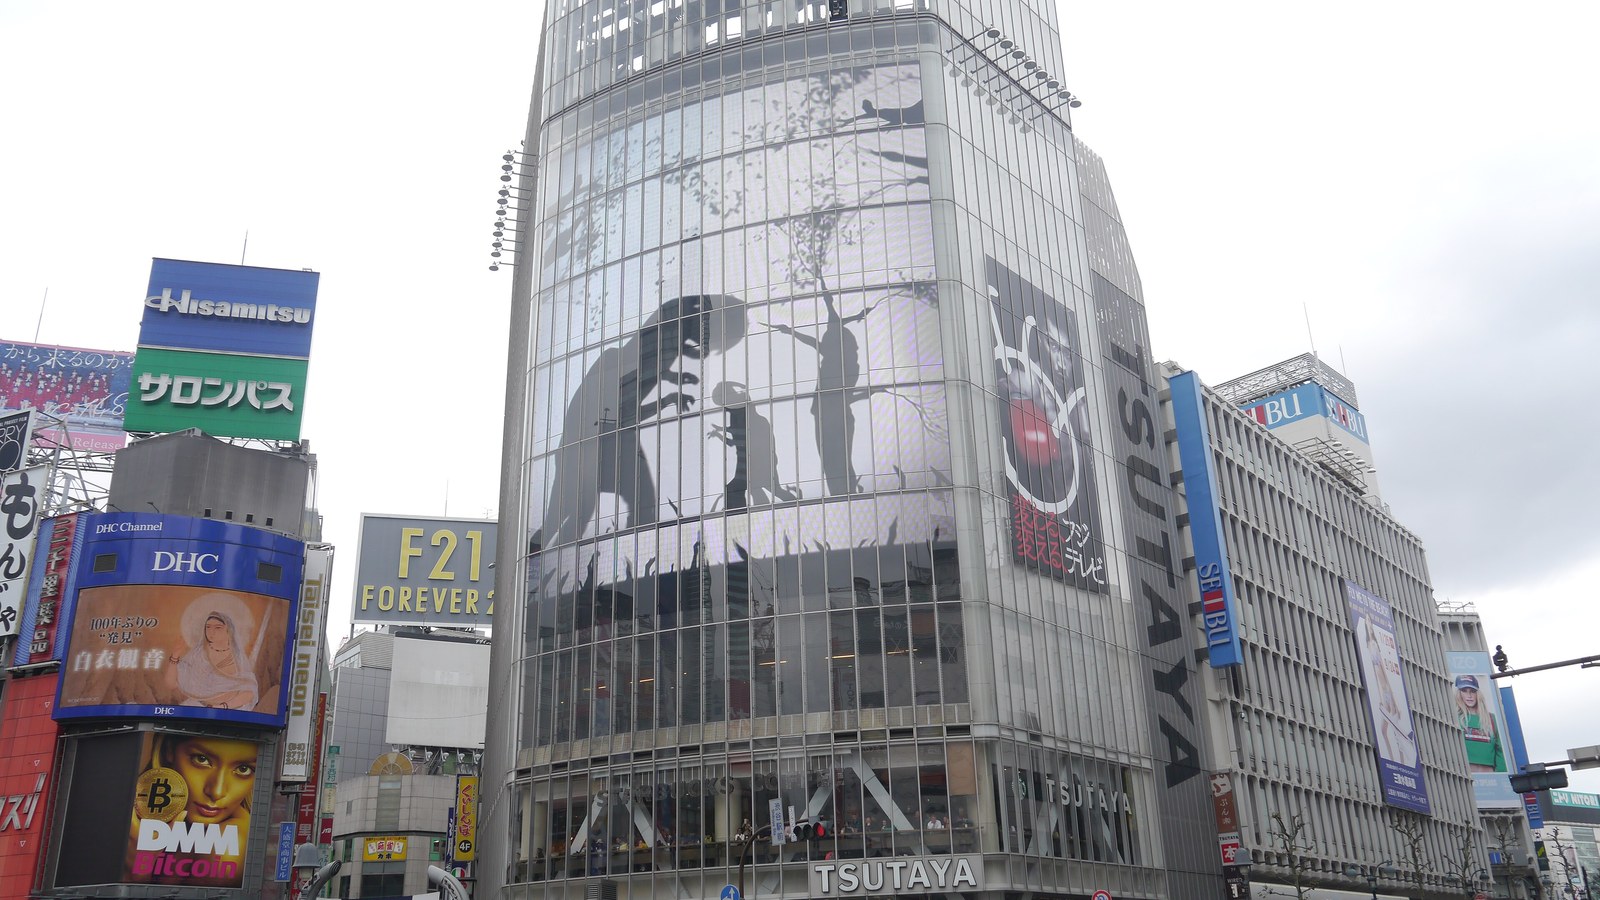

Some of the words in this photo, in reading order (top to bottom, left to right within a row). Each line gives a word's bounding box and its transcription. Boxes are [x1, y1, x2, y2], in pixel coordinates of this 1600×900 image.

[144, 287, 311, 324] Hisamitsu
[138, 372, 293, 412] サロンパス
[74, 437, 122, 450] Release
[96, 523, 119, 534] DHC
[120, 521, 163, 532] Channel
[1062, 518, 1089, 548] フジ
[151, 551, 219, 575] DHC
[398, 527, 482, 581] F21
[1065, 547, 1104, 584] テレビ
[1111, 343, 1201, 789] TSUTAYA
[298, 574, 323, 647] Taisei
[361, 584, 479, 615] FOREVER
[1199, 562, 1231, 648] SEIBU
[90, 616, 158, 631] 100年ぶりの
[74, 649, 164, 672] 白衣観音
[291, 653, 311, 717] neon
[154, 707, 175, 715] DHC
[0, 772, 47, 832] スリ
[1045, 780, 1132, 814] TSUTAYA
[1571, 795, 1600, 807] NITORI
[136, 818, 240, 856] DMM
[460, 843, 471, 851] 4F
[1223, 845, 1237, 861] 本
[132, 850, 237, 878] Bitcoin
[815, 858, 977, 893] TSUTAYA
